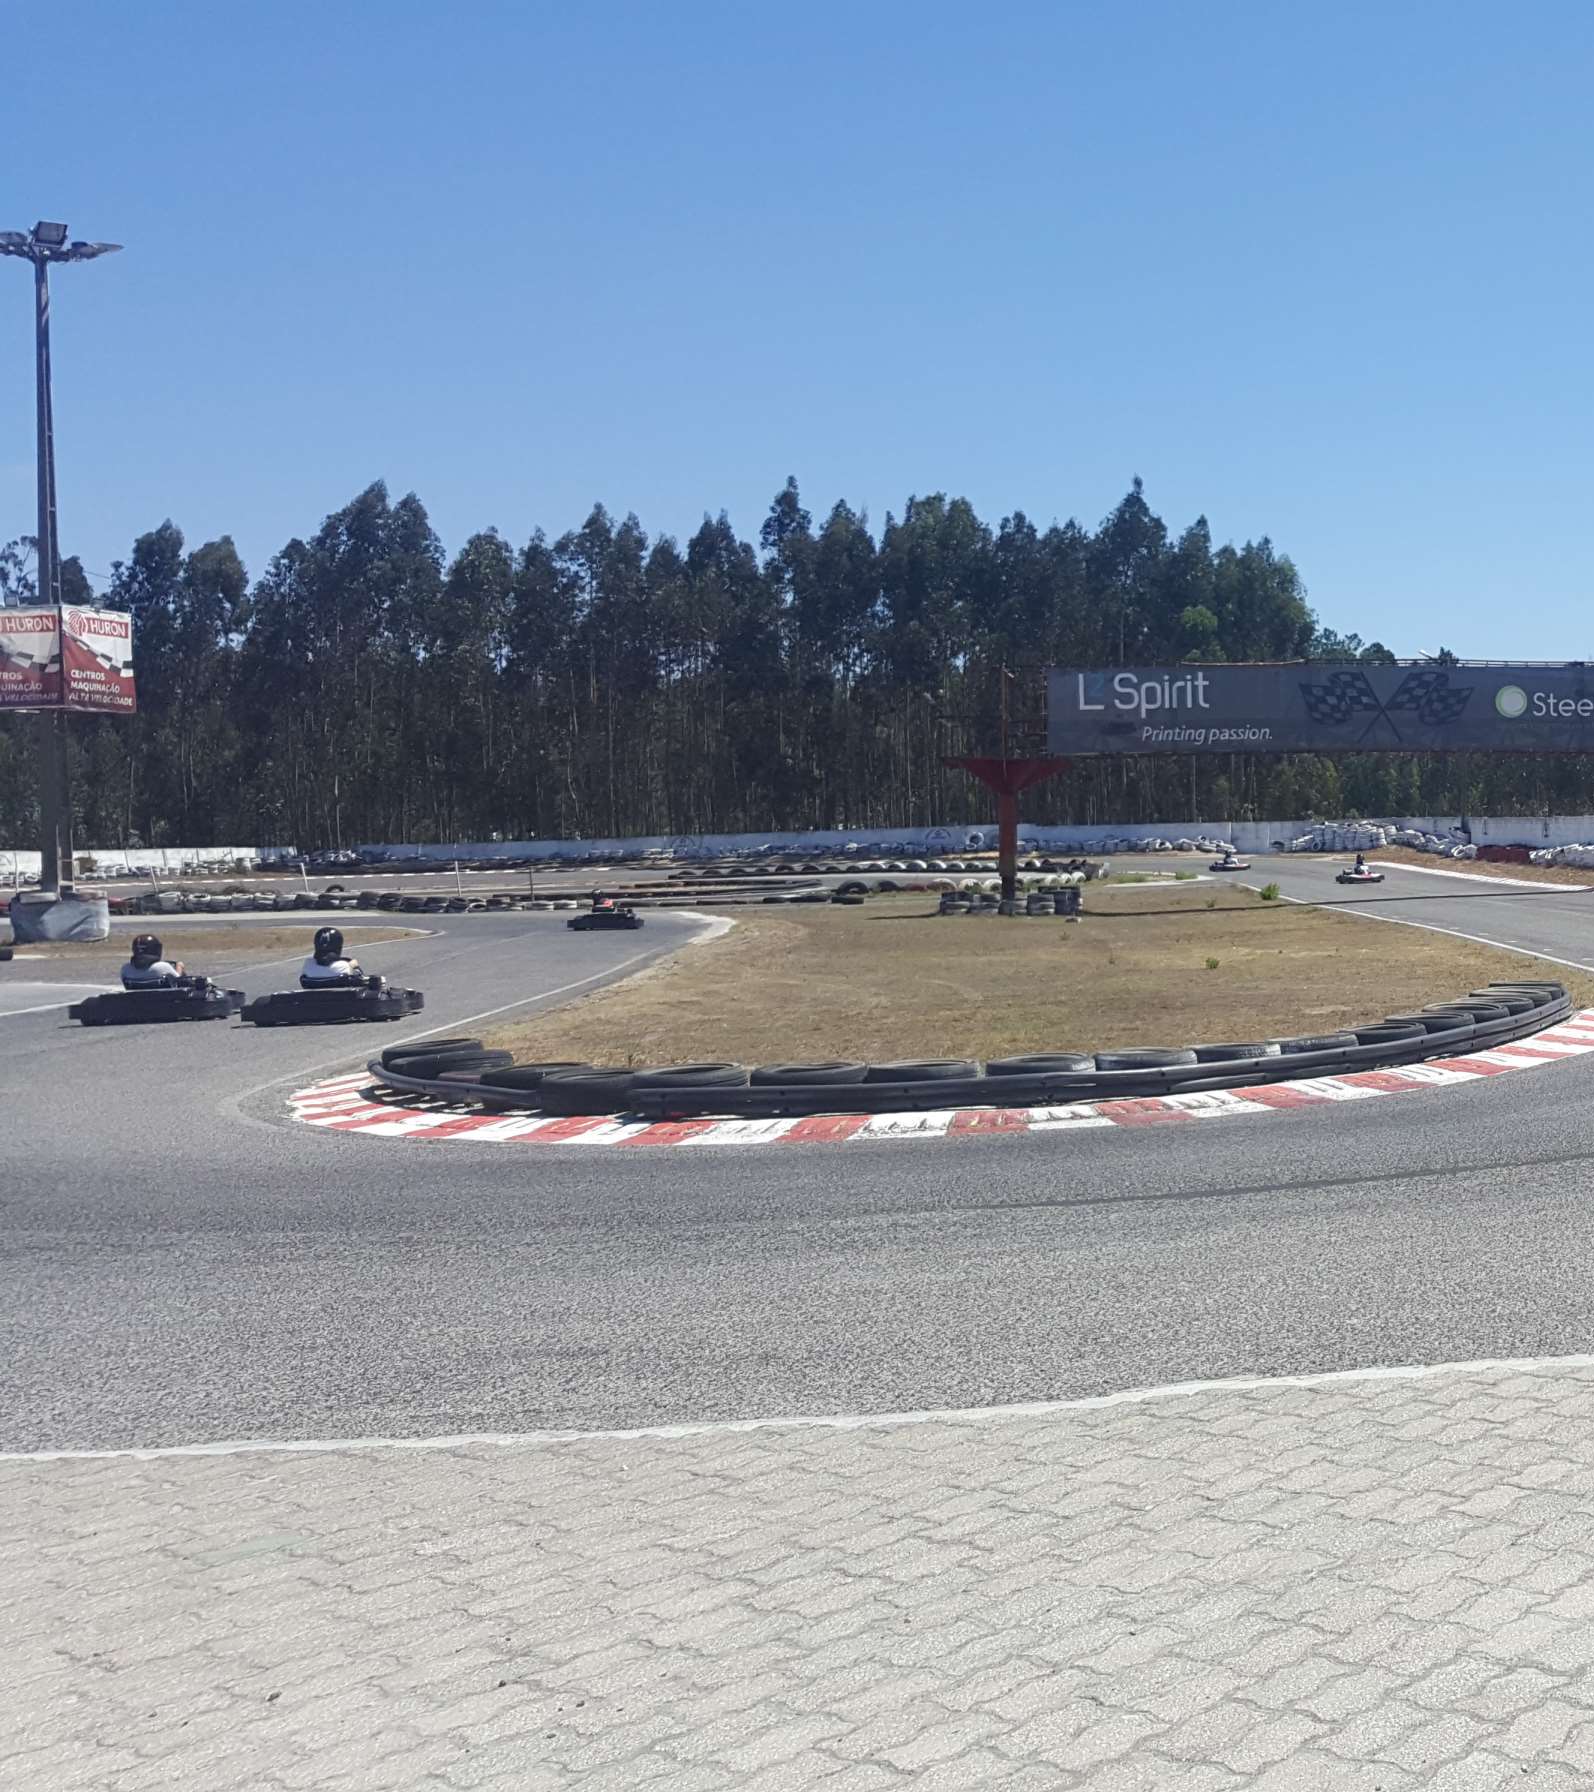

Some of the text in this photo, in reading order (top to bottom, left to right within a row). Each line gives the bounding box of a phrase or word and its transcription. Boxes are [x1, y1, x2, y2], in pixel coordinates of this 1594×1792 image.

[6, 617, 54, 632] HURON
[90, 619, 126, 637] HURON
[70, 669, 106, 681] CENTROS
[1113, 671, 1210, 719] Spirit
[1142, 724, 1273, 744] Printing passion.
